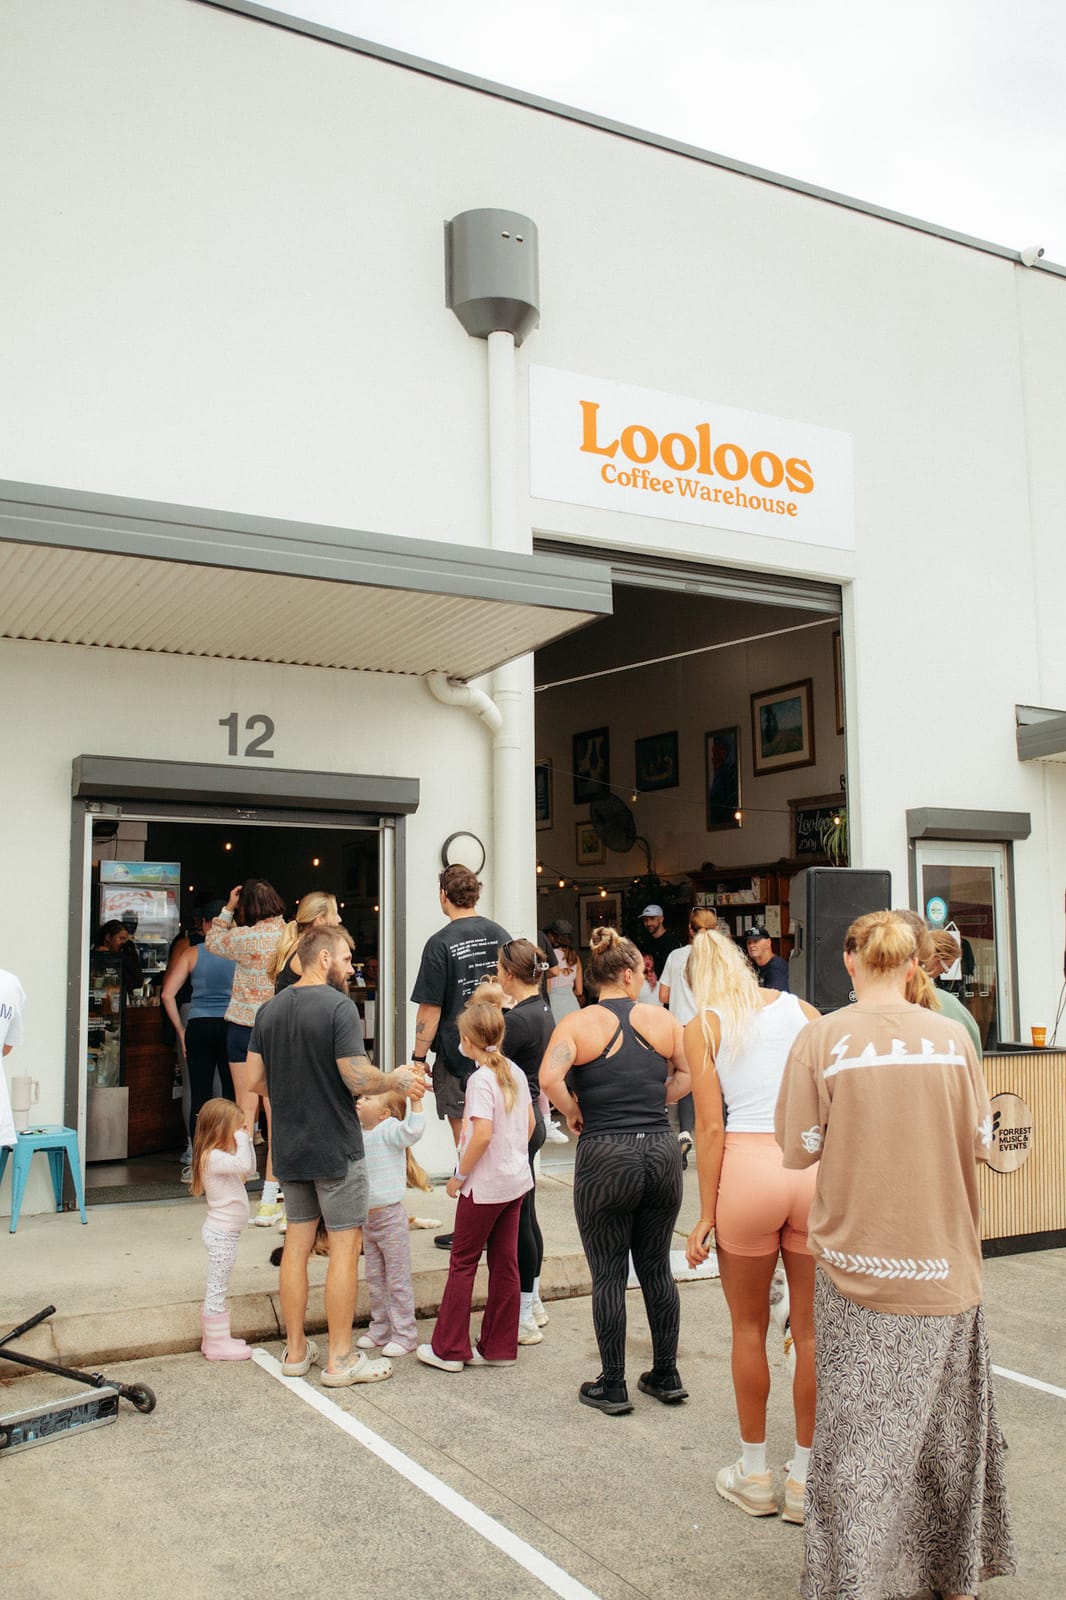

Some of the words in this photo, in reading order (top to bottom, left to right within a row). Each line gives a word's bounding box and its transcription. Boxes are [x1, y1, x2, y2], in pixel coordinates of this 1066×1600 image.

[579, 400, 815, 494] Looloos
[601, 463, 674, 494] Coffee
[675, 476, 798, 516] Warehouse
[218, 712, 274, 758] 12
[999, 1127, 1031, 1136] FORREST
[999, 1142, 1027, 1151] EVENTS
